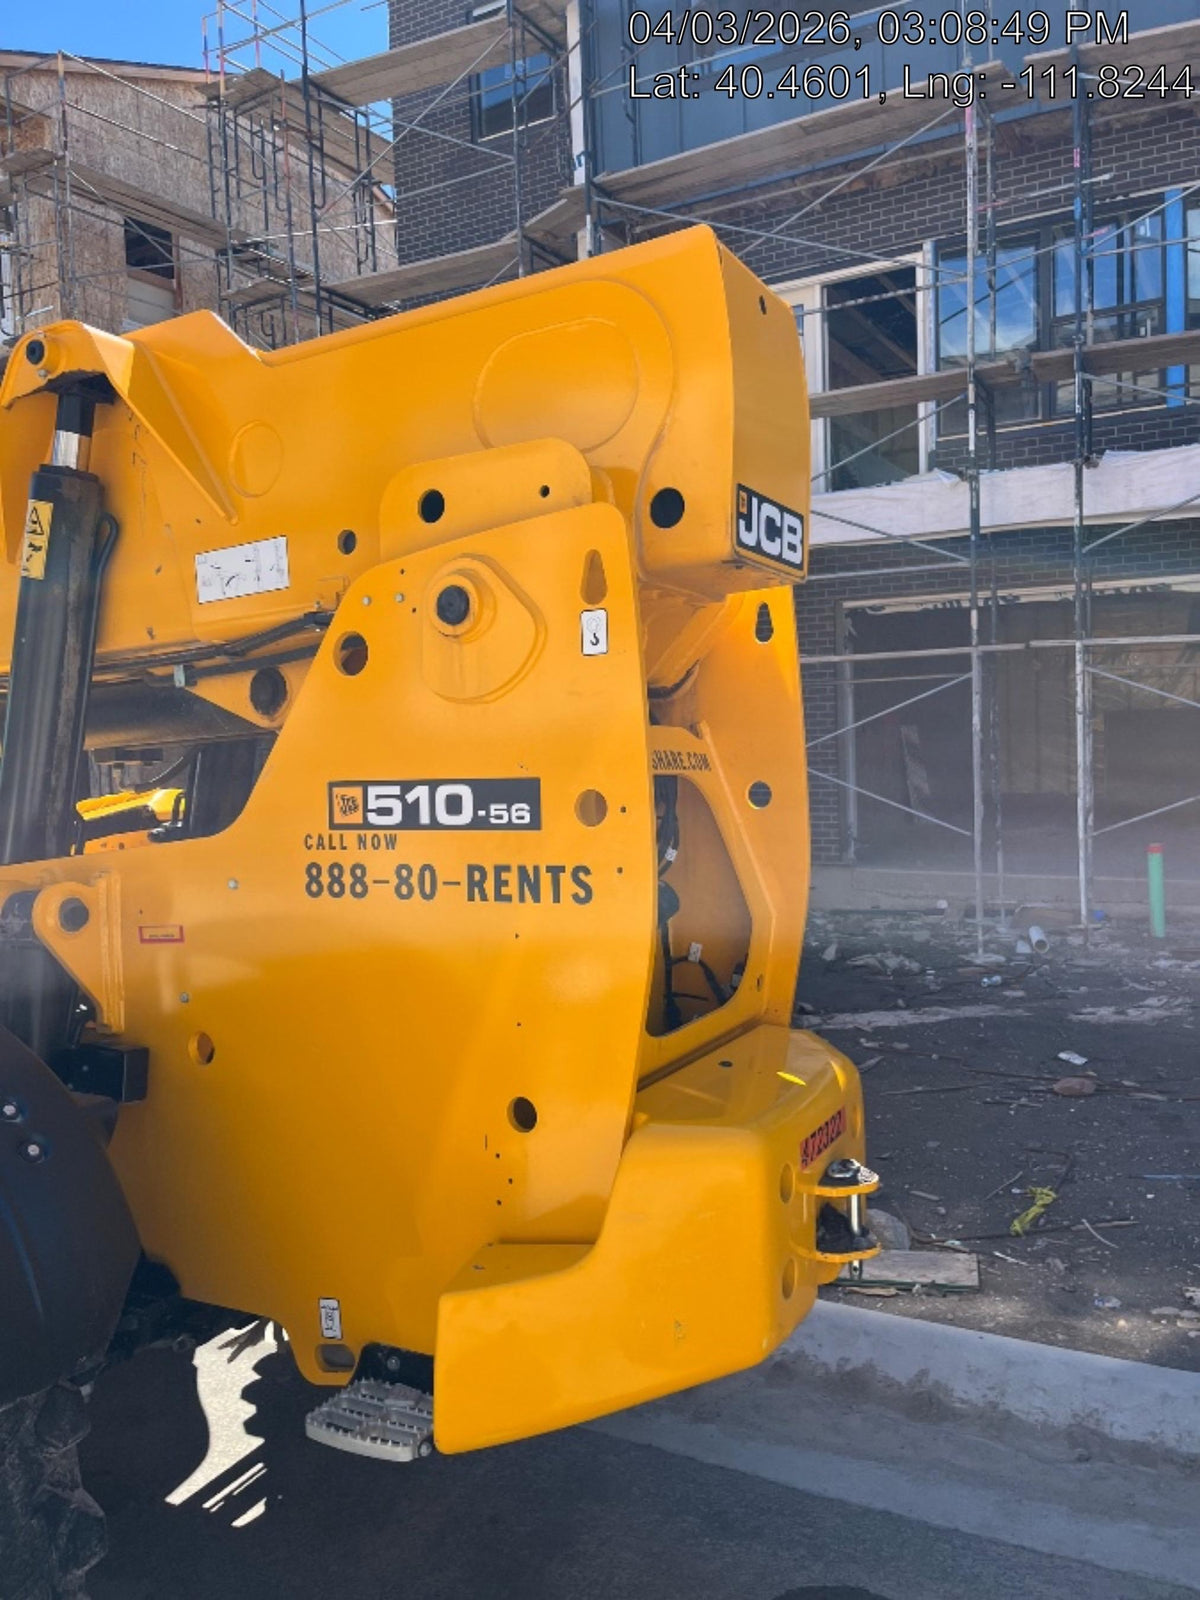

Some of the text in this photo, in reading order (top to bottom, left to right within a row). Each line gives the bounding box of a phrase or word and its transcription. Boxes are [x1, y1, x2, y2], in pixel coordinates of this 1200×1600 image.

[738, 496, 803, 564] JCB
[366, 783, 531, 827] 510-56
[304, 833, 398, 851] CALL NOW
[305, 862, 594, 905] 888-80-RENTS
